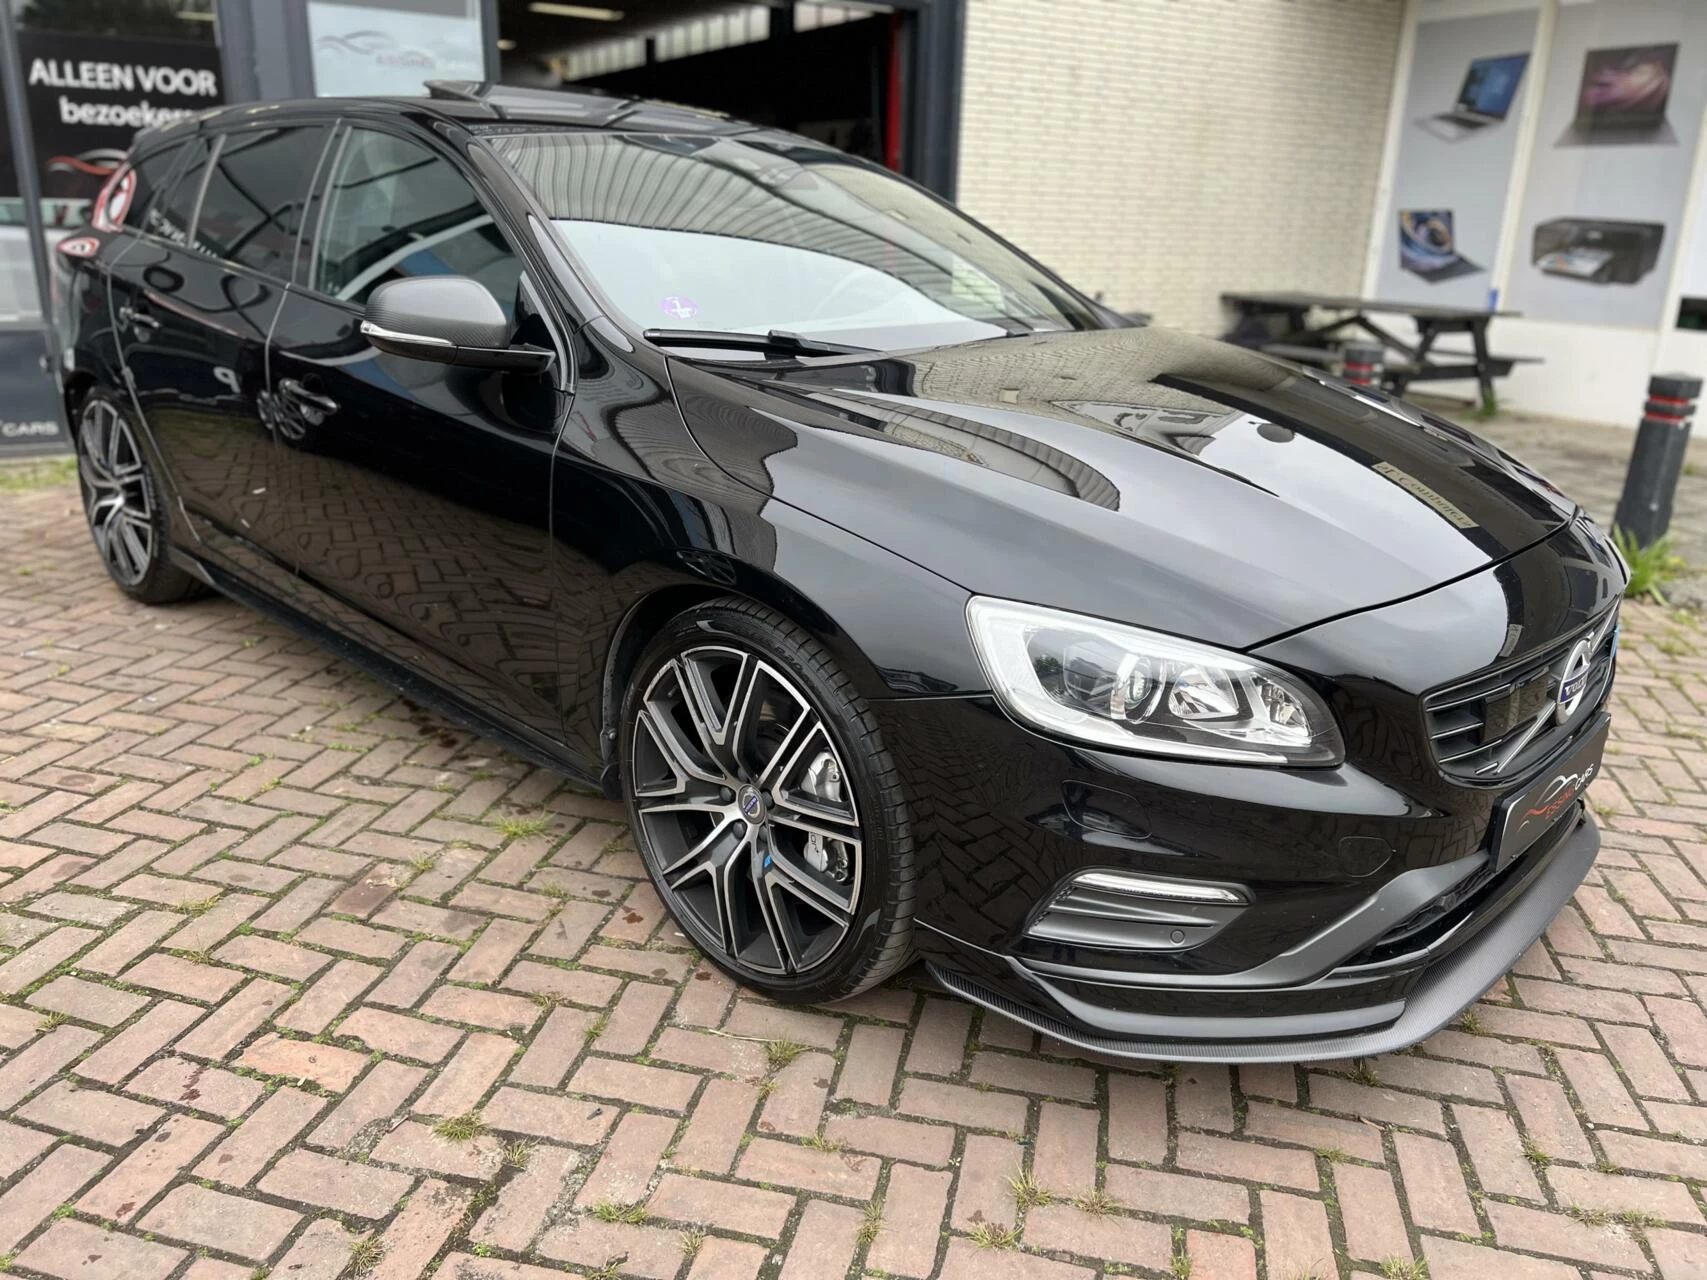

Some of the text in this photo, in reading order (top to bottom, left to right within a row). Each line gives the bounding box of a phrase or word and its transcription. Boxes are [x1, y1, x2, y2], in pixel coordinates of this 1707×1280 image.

[29, 58, 217, 97] ALLEEN VOOR
[2, 421, 59, 437] CARS
